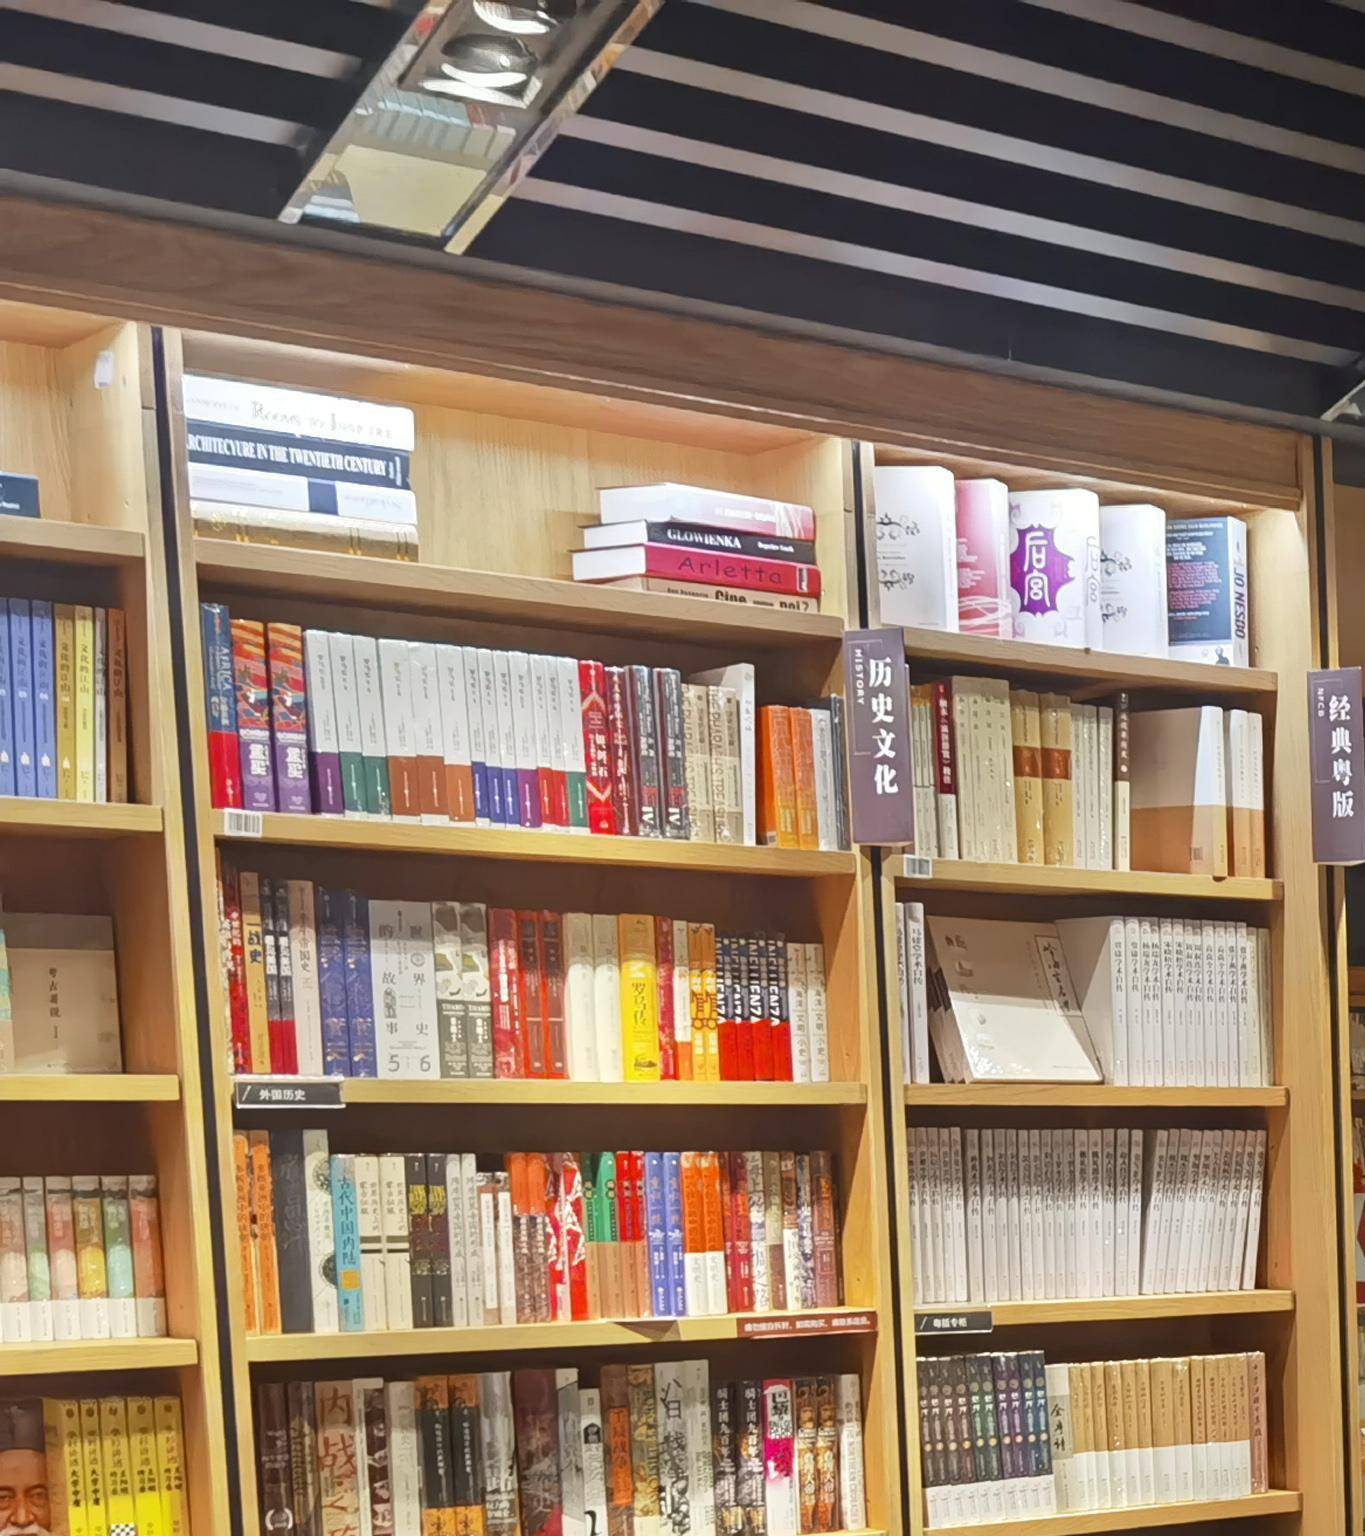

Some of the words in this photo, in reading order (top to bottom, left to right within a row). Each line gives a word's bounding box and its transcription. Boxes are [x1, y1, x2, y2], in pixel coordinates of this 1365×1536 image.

[678, 556, 783, 585] Arletta
[854, 649, 865, 706] HISTORY
[868, 656, 899, 795] 历史文化
[1328, 694, 1355, 819] 经典粤版
[259, 1088, 307, 1101] 外国历史
